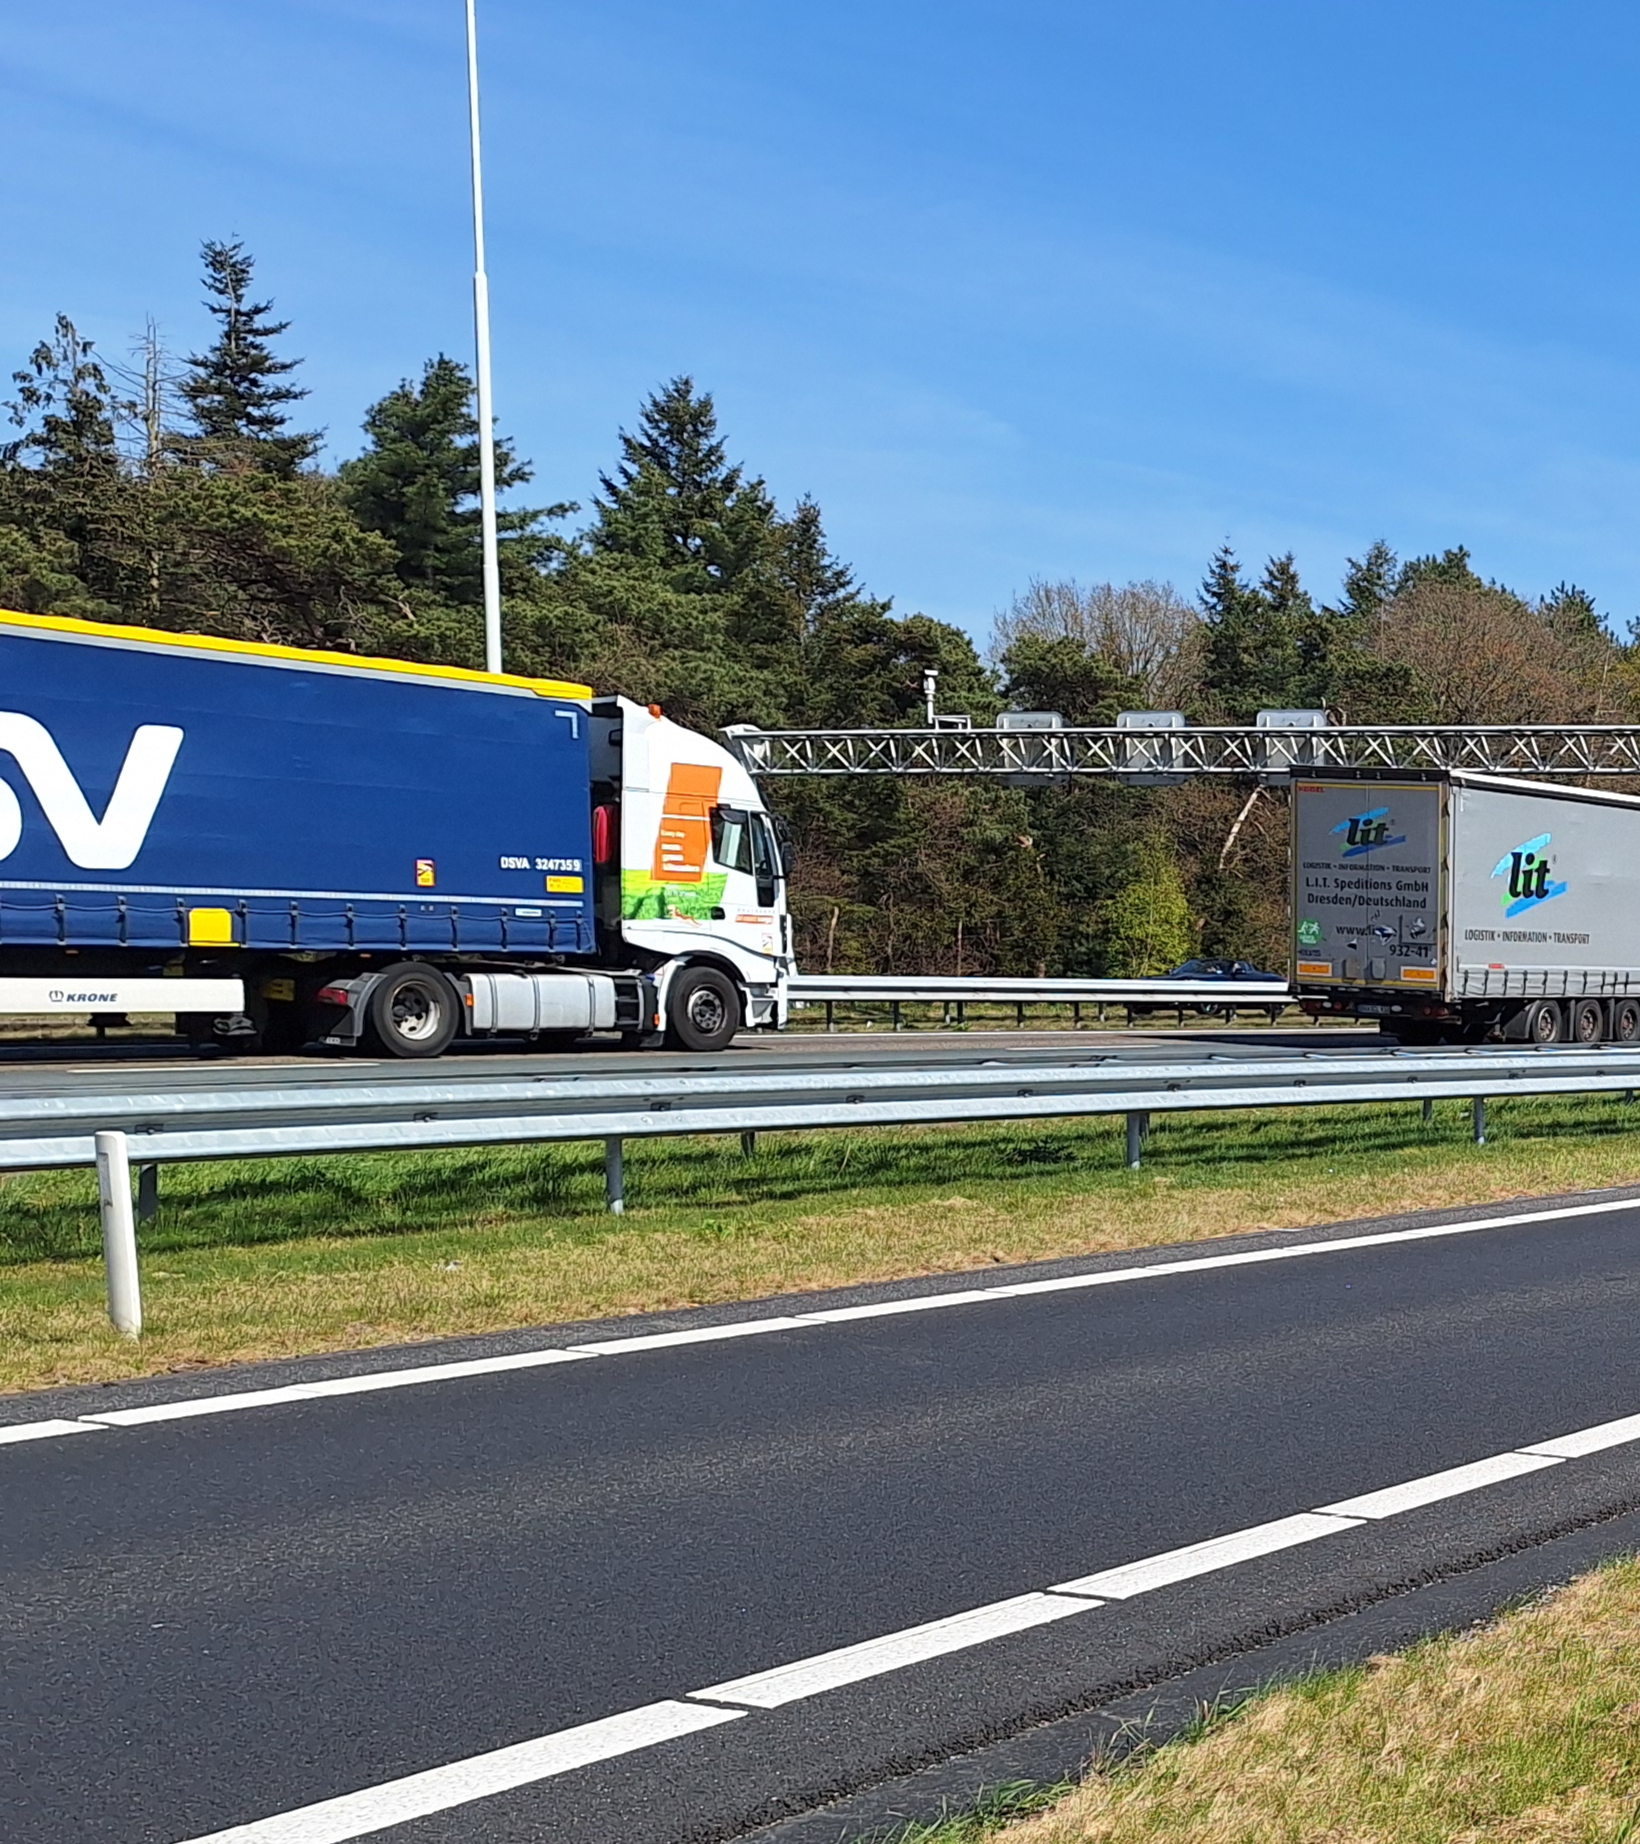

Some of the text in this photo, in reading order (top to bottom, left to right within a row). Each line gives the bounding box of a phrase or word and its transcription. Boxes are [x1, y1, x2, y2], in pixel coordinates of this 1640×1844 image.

[1346, 818, 1389, 846] lit
[500, 856, 582, 872] DSVA 3247359
[1302, 861, 1432, 874] LOGISTIK INFORMATION TRANSPORT
[1509, 852, 1550, 899] lit
[1305, 877, 1429, 893] L.I.T. Speditions GmbH
[1307, 893, 1427, 909] Dresden/Deutschland
[1464, 929, 1590, 944] LOGISTIK INFORMATION TRANSPORT
[66, 992, 118, 1002] KRONE
